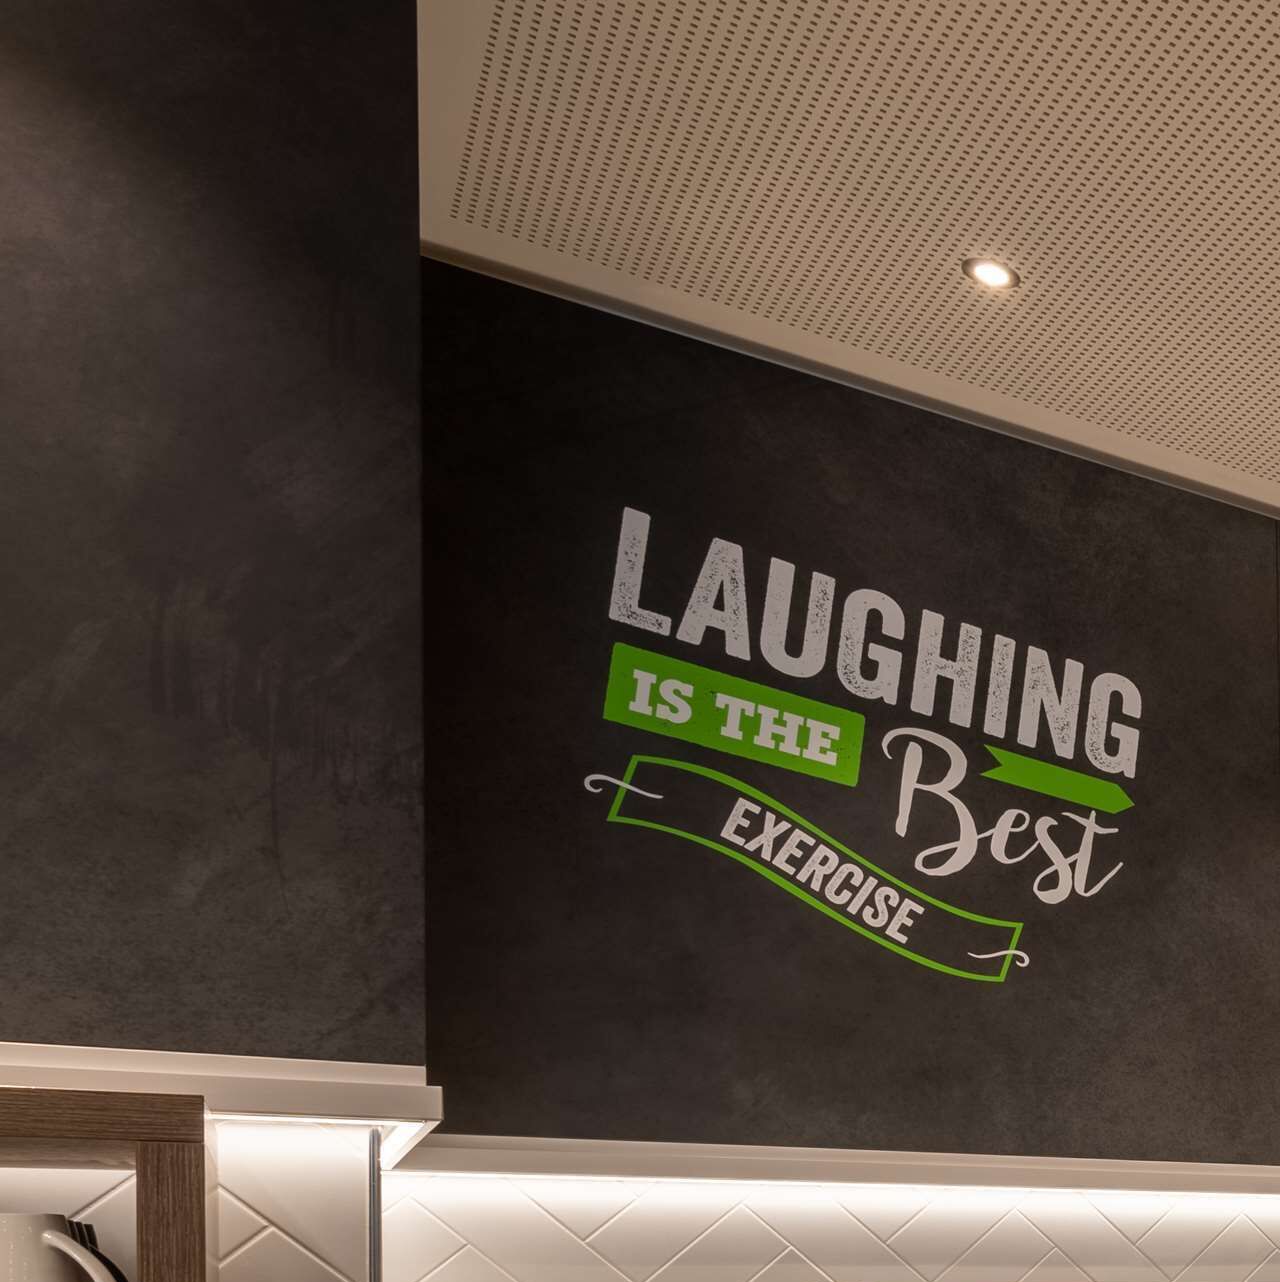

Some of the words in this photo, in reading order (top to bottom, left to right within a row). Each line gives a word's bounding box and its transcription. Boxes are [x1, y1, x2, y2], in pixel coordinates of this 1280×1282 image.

[608, 506, 1143, 779] LAUGHING
[628, 669, 694, 724] IS
[715, 693, 841, 766] THE
[719, 797, 925, 944] EXERCISE
[881, 727, 1124, 904] Best
